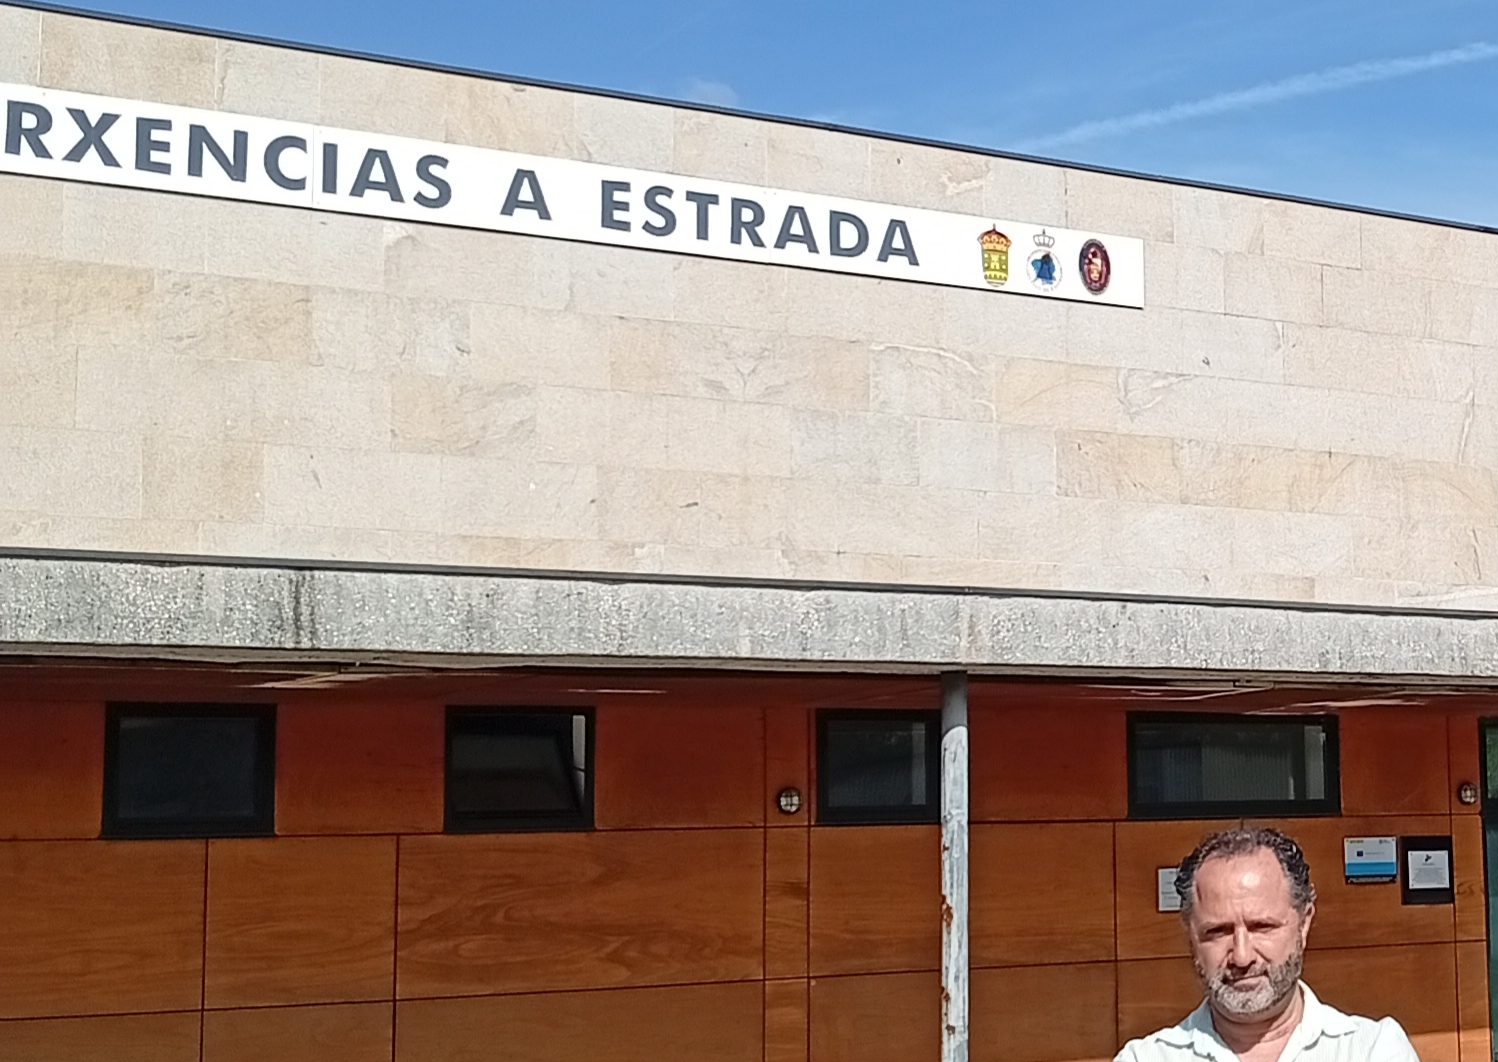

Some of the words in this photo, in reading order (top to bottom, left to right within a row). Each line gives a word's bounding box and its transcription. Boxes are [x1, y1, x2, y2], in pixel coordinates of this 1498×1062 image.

[4, 99, 453, 209] RXENCIAS
[500, 168, 552, 220] A
[600, 179, 920, 267] ESTRADA
